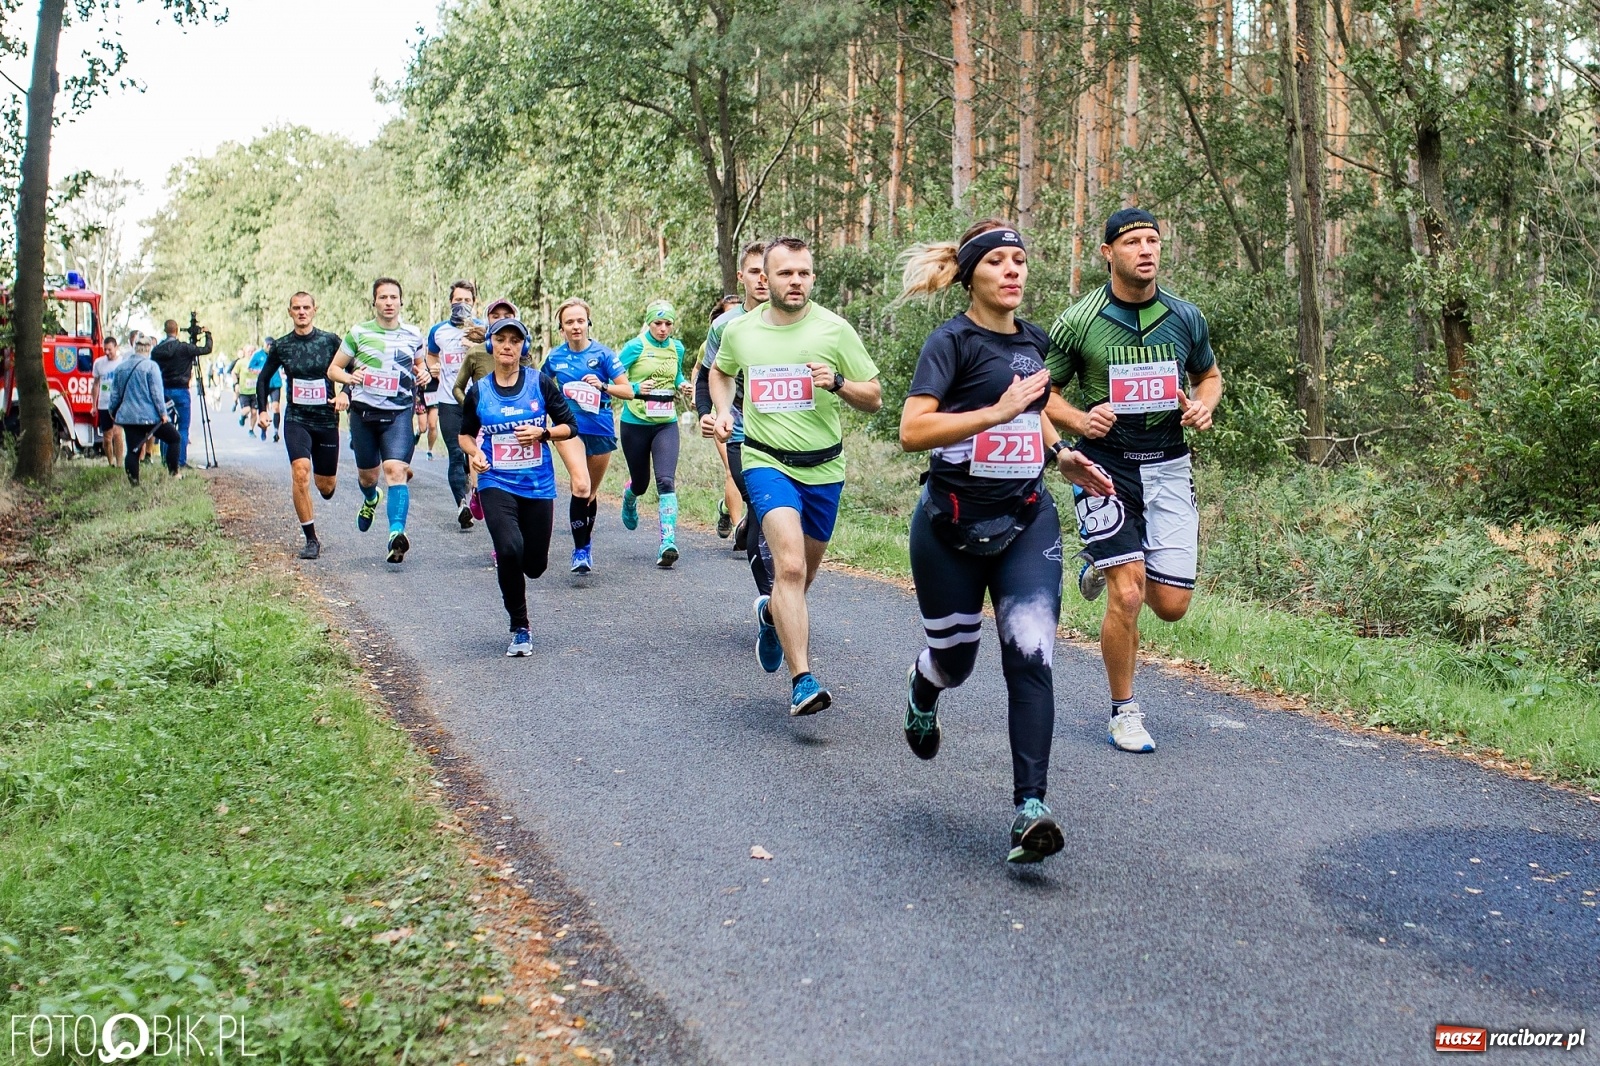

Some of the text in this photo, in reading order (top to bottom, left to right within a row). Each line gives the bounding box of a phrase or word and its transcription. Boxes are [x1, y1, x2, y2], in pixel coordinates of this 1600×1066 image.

[370, 376, 393, 389] 221
[758, 380, 803, 400] 208
[1124, 379, 1164, 401] 218
[298, 388, 321, 399] 230
[570, 390, 595, 405] 209
[500, 445, 534, 461] 228
[987, 436, 1035, 461] 225
